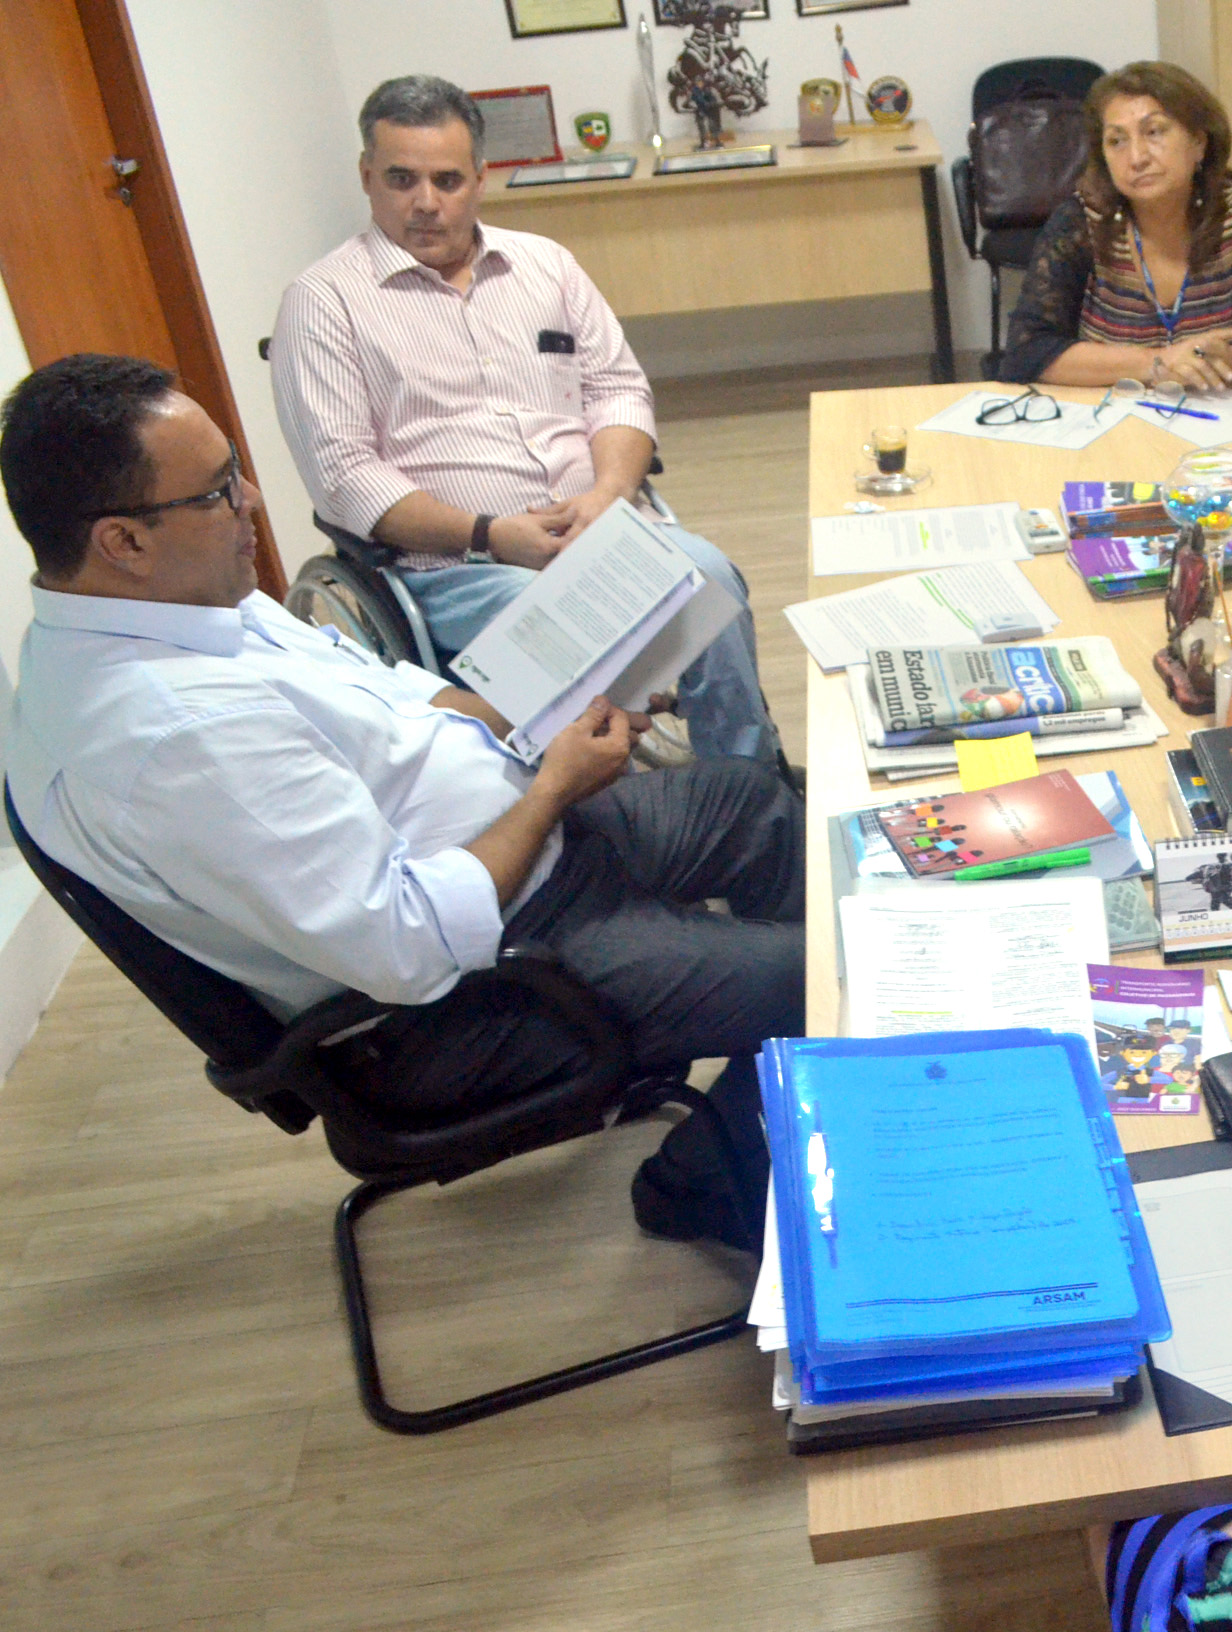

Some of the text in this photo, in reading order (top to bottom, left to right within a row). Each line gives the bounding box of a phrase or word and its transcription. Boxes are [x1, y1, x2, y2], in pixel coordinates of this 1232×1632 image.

[875, 650, 895, 675] em
[902, 649, 933, 701] Estado
[1178, 912, 1209, 923] JUNHO
[1033, 1291, 1086, 1305] ARSAM
